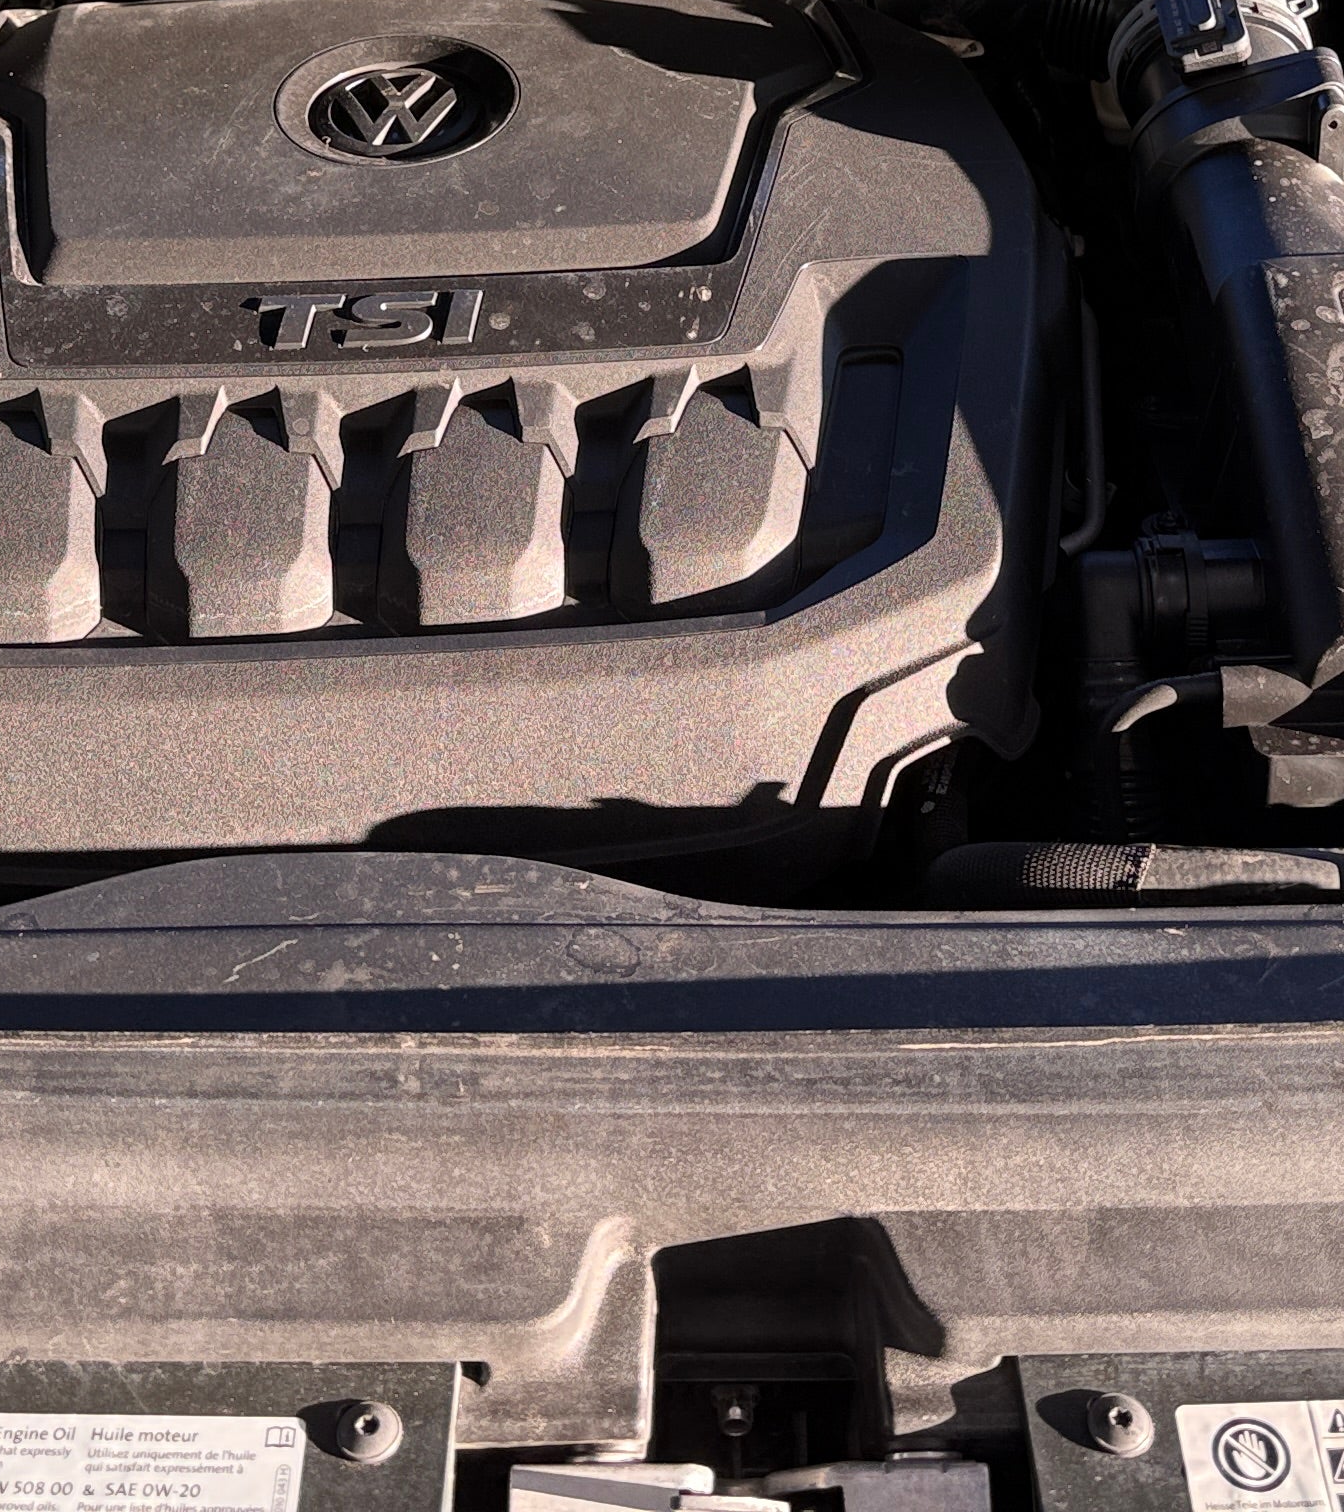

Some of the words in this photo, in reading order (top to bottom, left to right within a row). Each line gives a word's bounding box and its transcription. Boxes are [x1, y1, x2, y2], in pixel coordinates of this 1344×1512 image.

[257, 289, 485, 351] TSI
[53, 1426, 77, 1441] Oil
[90, 1427, 133, 1442] Huile
[138, 1429, 199, 1443] moteur
[20, 1447, 72, 1458] expressly
[87, 1448, 129, 1460] Utilisez
[133, 1450, 203, 1462] uniquement
[205, 1450, 220, 1460] de
[222, 1449, 256, 1461] l'huile
[84, 1462, 103, 1473] qui
[105, 1462, 150, 1474] satisfait
[154, 1462, 233, 1476] expressément
[236, 1463, 244, 1474] à
[12, 1481, 45, 1495] 508
[50, 1481, 74, 1496] 00
[82, 1484, 95, 1496] &
[104, 1482, 137, 1497] SAE
[142, 1483, 202, 1498] 0W-20
[77, 1501, 103, 1512] Pour
[106, 1504, 126, 1512] une
[130, 1502, 153, 1512] liste
